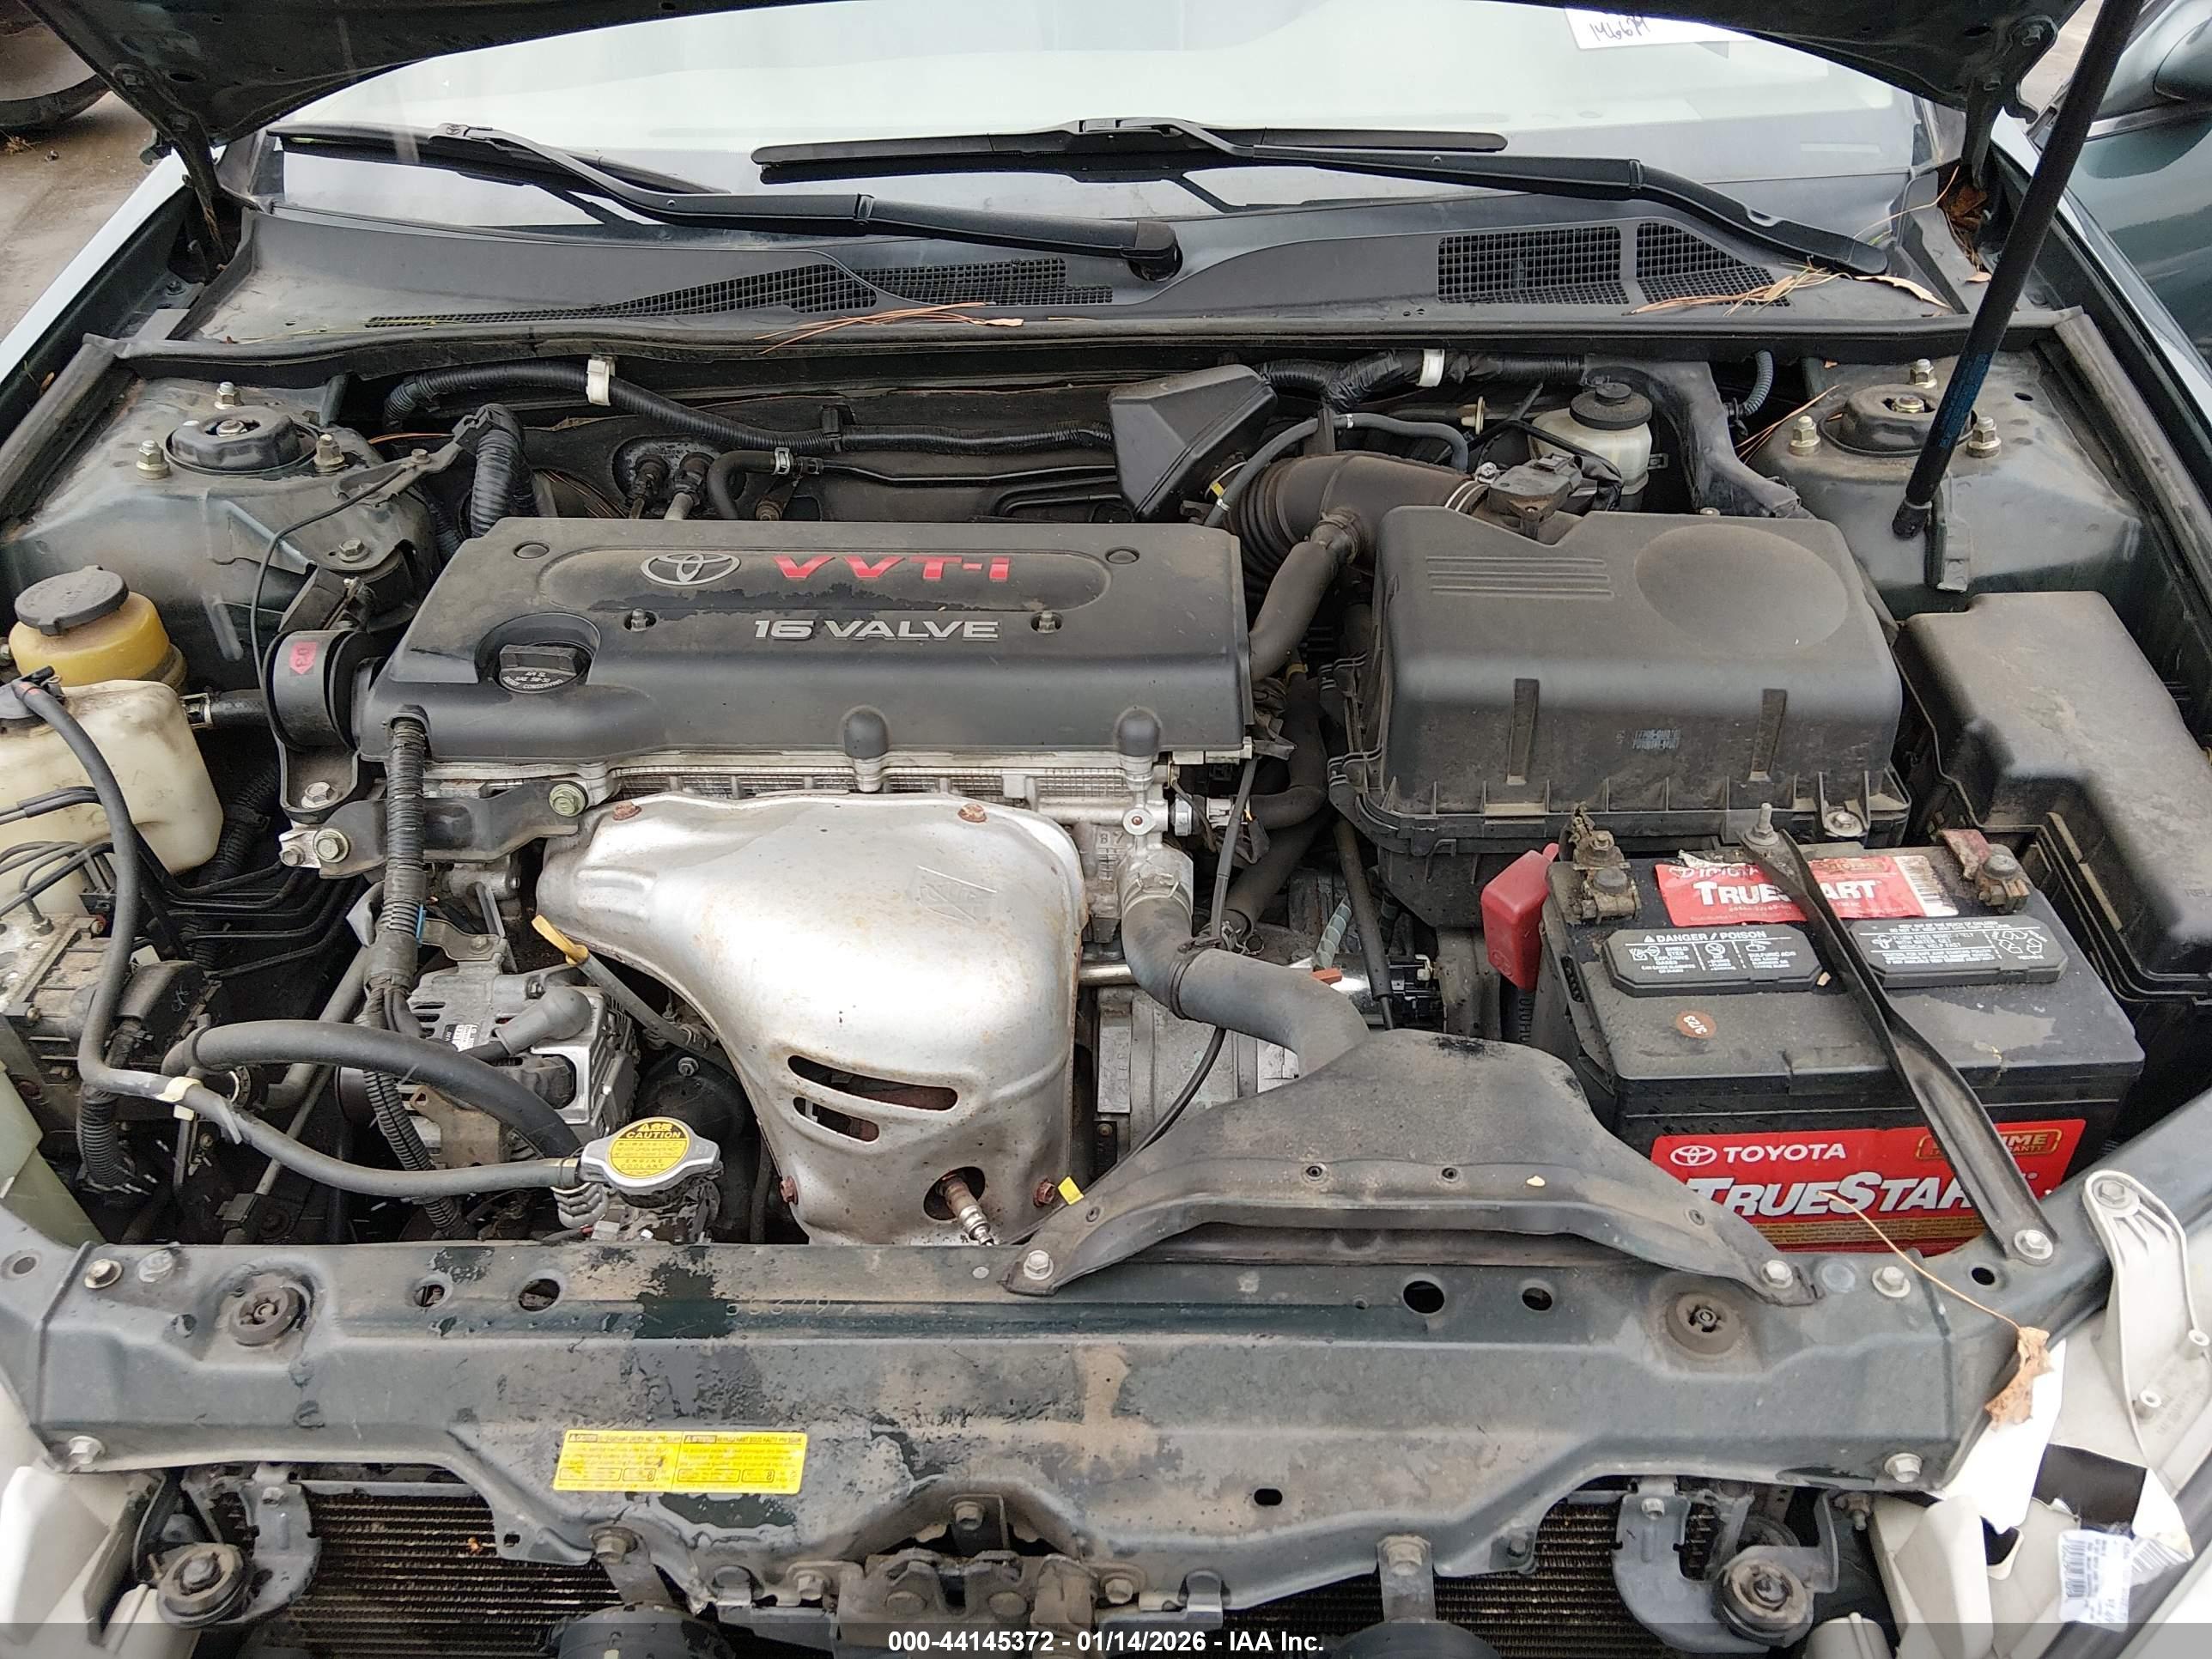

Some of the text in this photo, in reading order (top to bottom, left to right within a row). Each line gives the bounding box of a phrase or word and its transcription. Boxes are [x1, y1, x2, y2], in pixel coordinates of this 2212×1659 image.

[754, 620, 1000, 641] 16 VALVE
[1656, 933, 1708, 943] DANGER
[1719, 930, 1767, 939] POISON
[626, 1131, 682, 1139] CAUTION
[1723, 1143, 1847, 1163] TOYOTA
